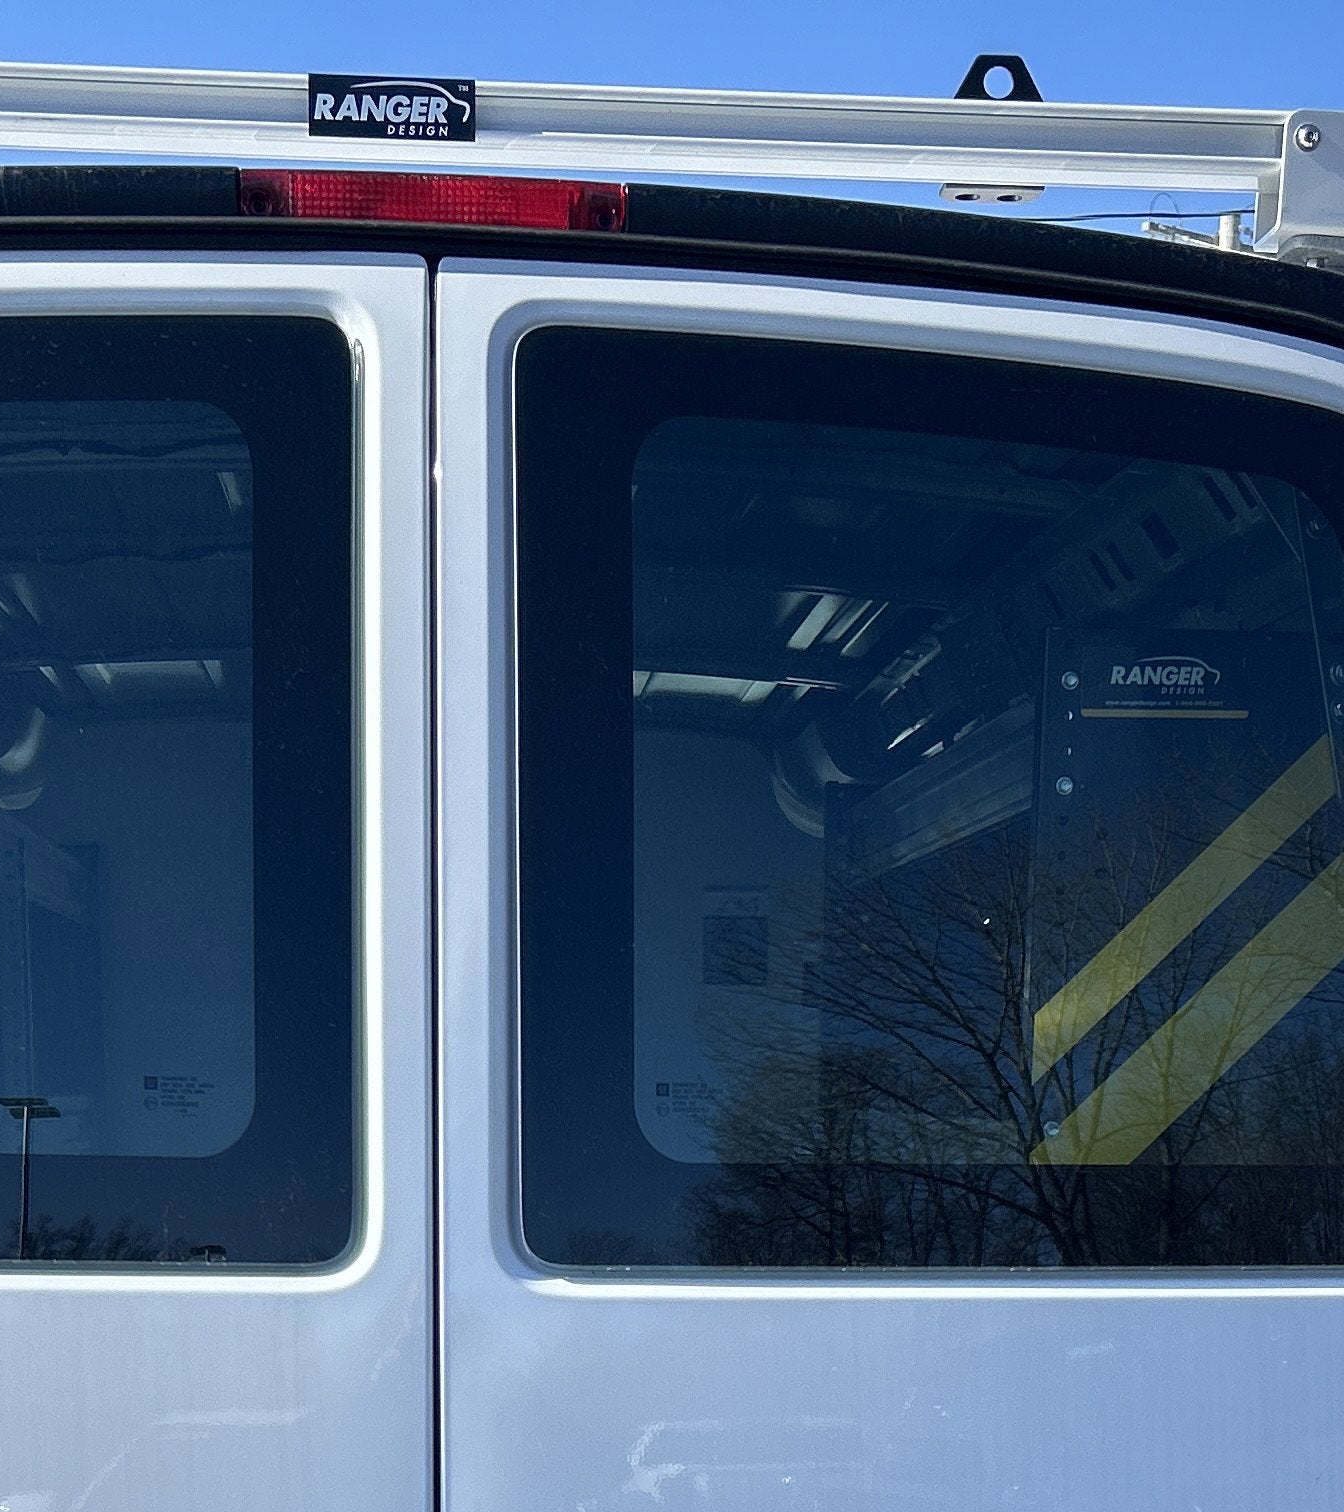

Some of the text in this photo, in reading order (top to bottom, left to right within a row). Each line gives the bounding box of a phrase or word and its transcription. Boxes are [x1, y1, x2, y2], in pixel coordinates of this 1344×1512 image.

[313, 93, 449, 124] RANGER
[387, 125, 449, 137] DESIGN
[1110, 665, 1205, 686] RANGER
[1160, 687, 1205, 695] DESIGN
